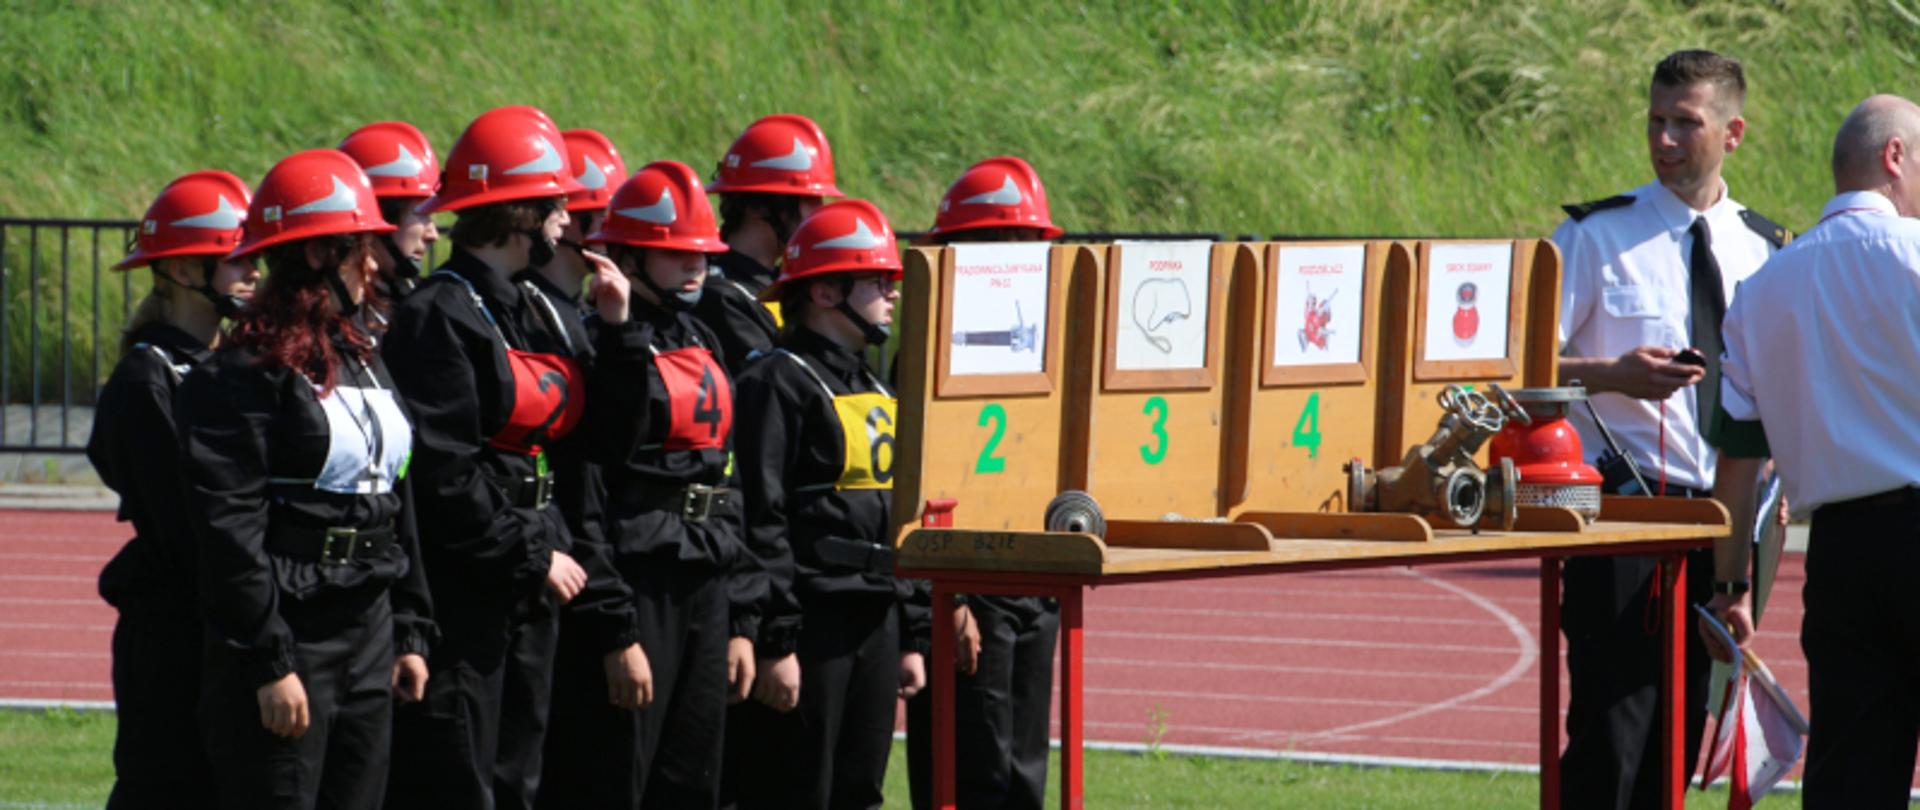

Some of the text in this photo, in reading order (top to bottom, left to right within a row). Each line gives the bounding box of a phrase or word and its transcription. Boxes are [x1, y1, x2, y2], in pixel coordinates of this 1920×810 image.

[522, 371, 569, 447] 2
[693, 364, 722, 440] 4
[975, 402, 1007, 474] 2
[1139, 396, 1168, 465] 3
[1292, 391, 1322, 459] 4
[865, 406, 896, 483] 6
[915, 532, 953, 552] OSP
